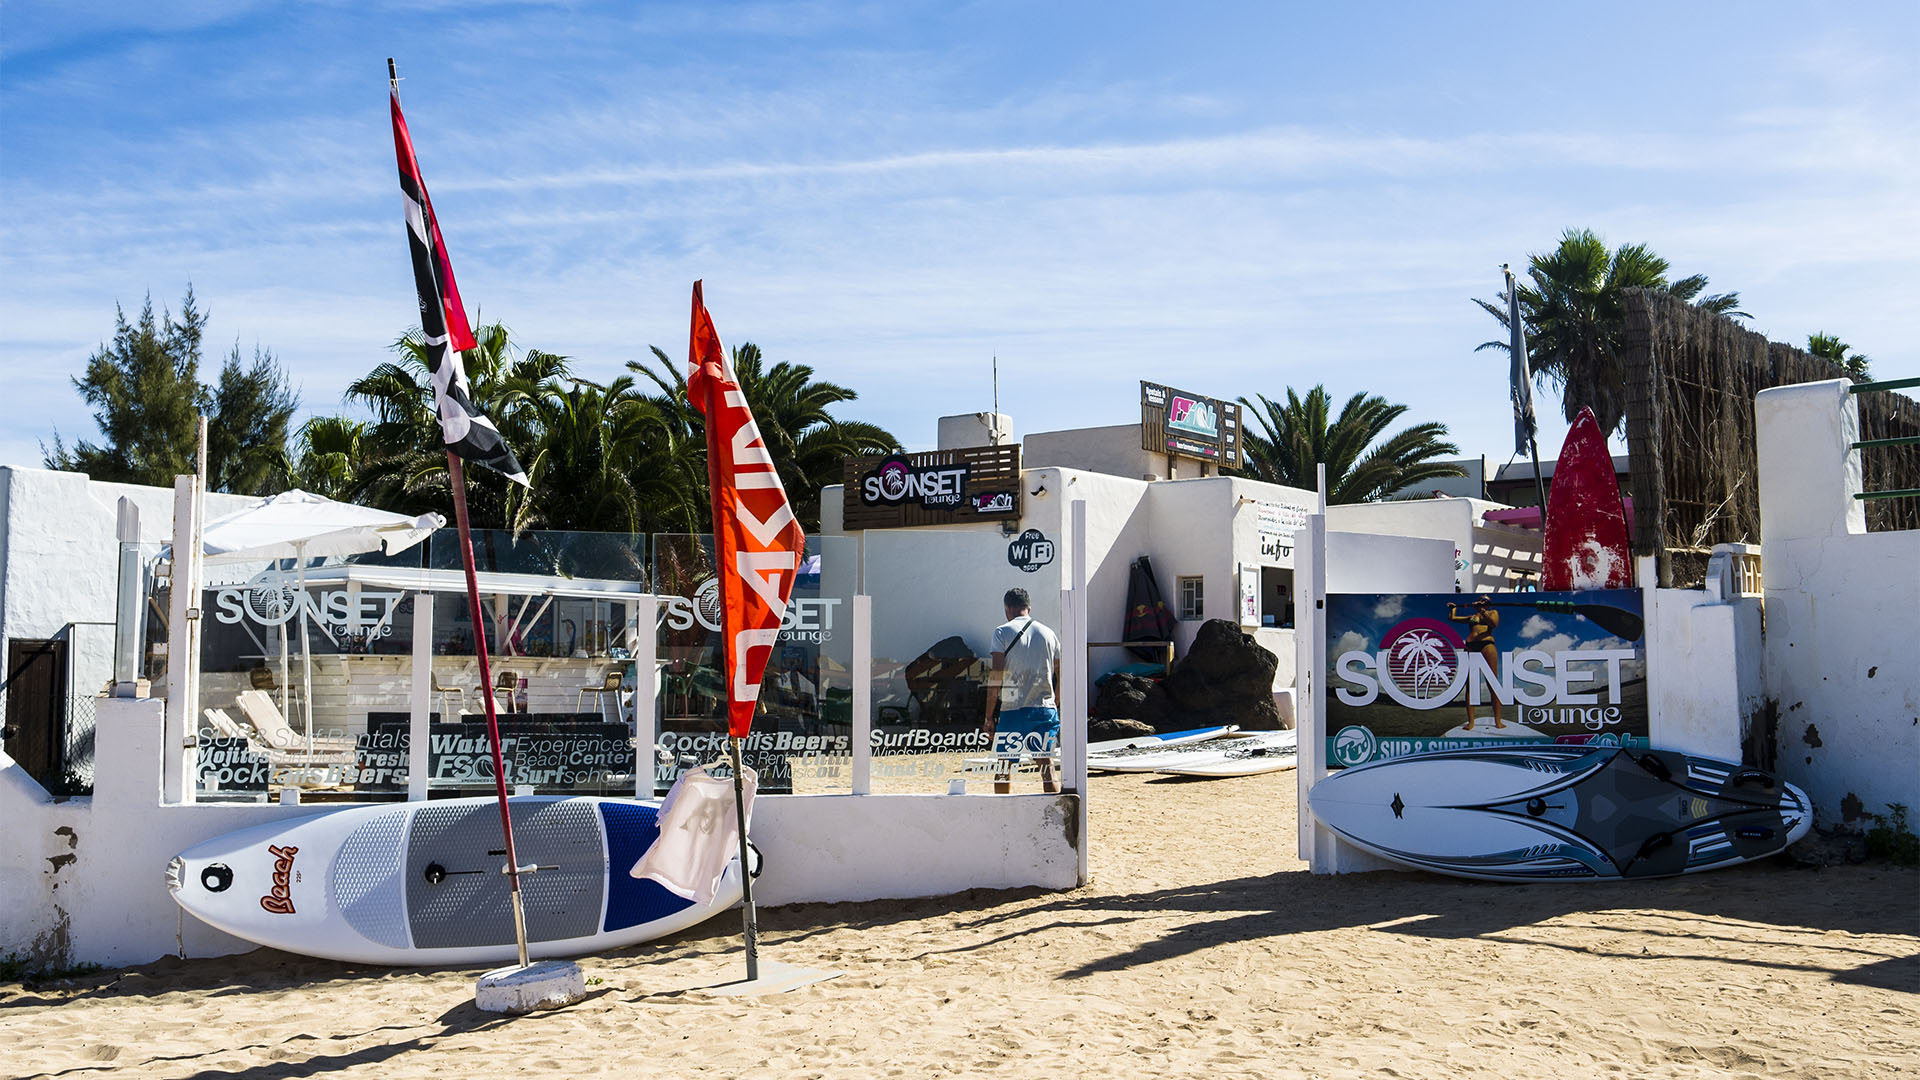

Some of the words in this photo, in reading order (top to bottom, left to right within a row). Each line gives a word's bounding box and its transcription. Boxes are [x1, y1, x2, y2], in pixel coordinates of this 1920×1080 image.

[865, 469, 967, 501] SUNSET
[1024, 531, 1040, 540] Free
[1012, 544, 1028, 559] Wi
[1035, 543, 1051, 559] Fi
[1261, 535, 1295, 562] info
[667, 597, 842, 632] SUSET
[1335, 648, 1636, 710] SUNSET
[327, 728, 411, 749] Rentals
[515, 736, 634, 755] Experiences
[774, 731, 849, 751] Beers
[870, 728, 990, 748] SurfBoards
[197, 746, 271, 767] Mojitos
[354, 749, 410, 767] Fresh
[514, 752, 569, 767] Beach
[569, 751, 634, 765] Center
[801, 749, 851, 766] Chill
[1380, 740, 1412, 760] SUP
[260, 844, 300, 914] Beach
